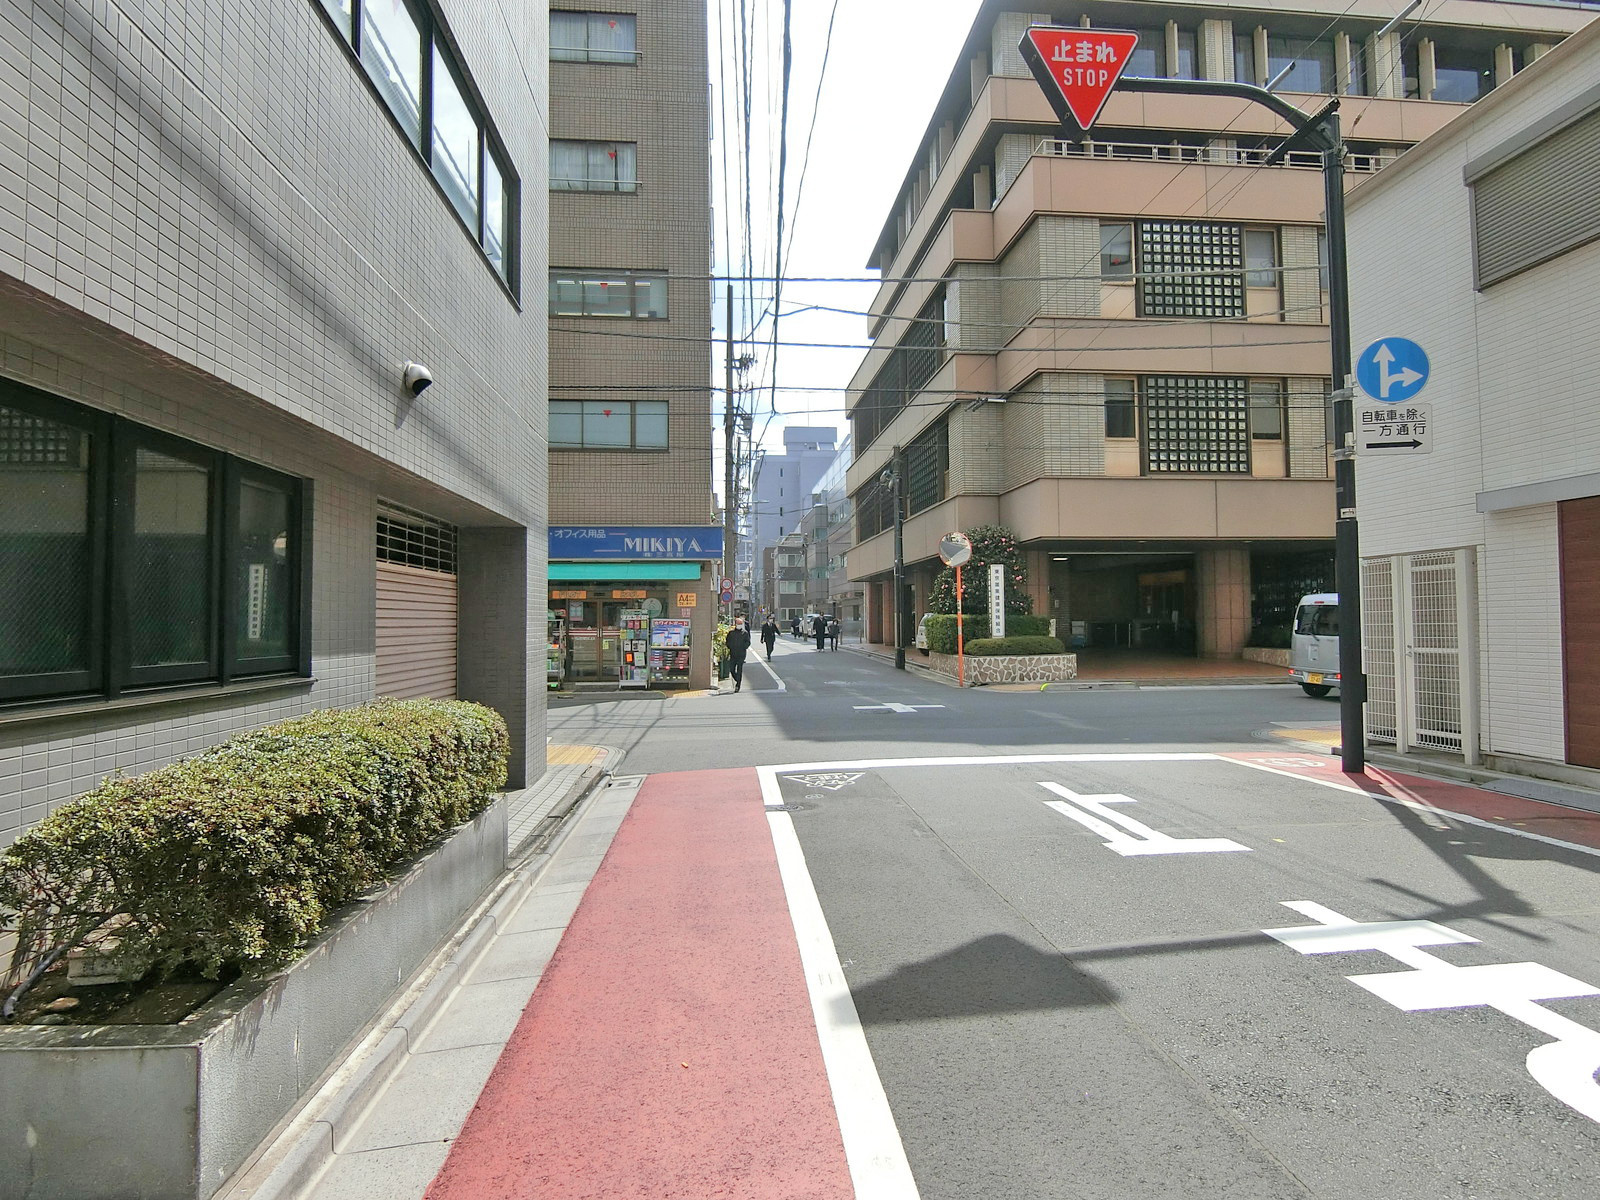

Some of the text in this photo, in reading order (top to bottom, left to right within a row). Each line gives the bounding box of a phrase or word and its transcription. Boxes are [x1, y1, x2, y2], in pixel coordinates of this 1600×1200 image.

[1052, 39, 1117, 63] 止まれ
[1064, 69, 1108, 87] STOP
[1363, 409, 1426, 422] 自転車を除く
[1363, 424, 1426, 437] 一方通行
[624, 538, 702, 552] MIKIYA
